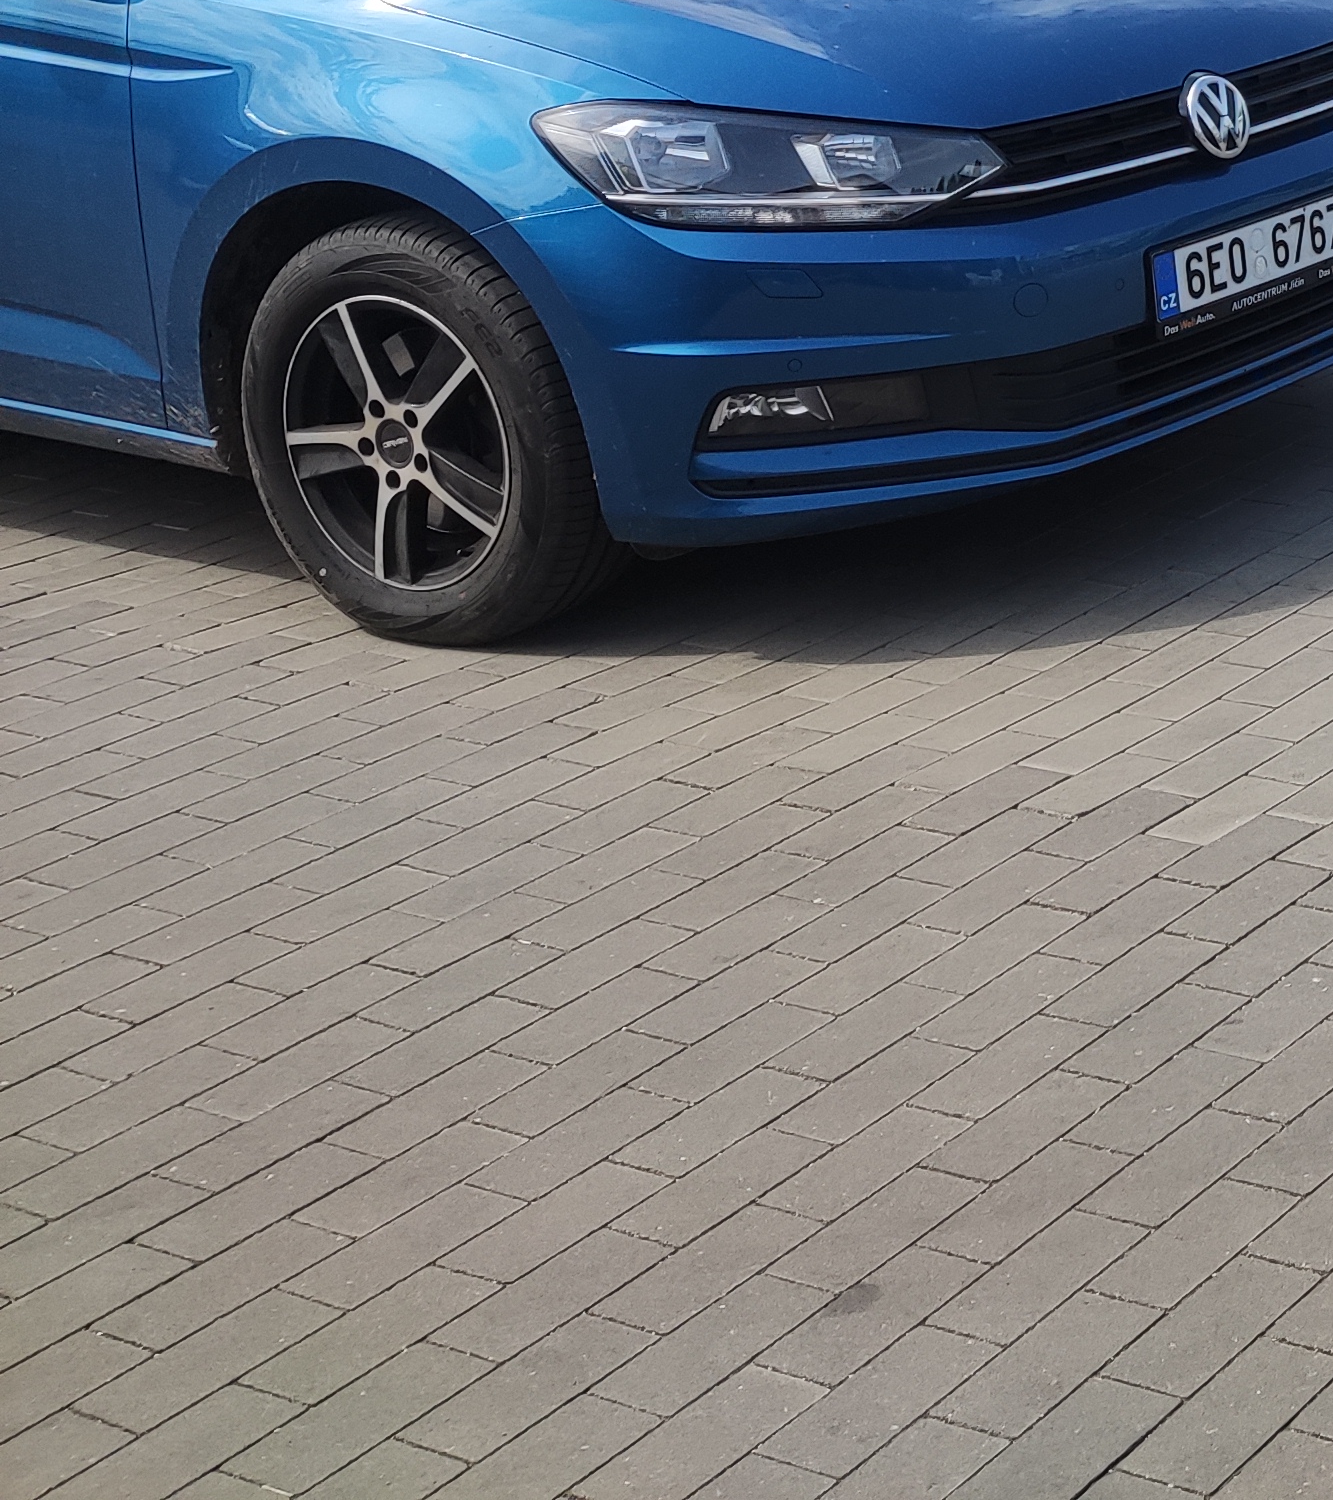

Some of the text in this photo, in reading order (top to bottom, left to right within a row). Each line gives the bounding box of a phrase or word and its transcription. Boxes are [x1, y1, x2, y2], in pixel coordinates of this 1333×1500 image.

[1185, 237, 1247, 299] 6E0
[1160, 292, 1178, 311] CZ
[1231, 282, 1288, 312] AUTOCENTRUM
[1164, 324, 1179, 337] Das
